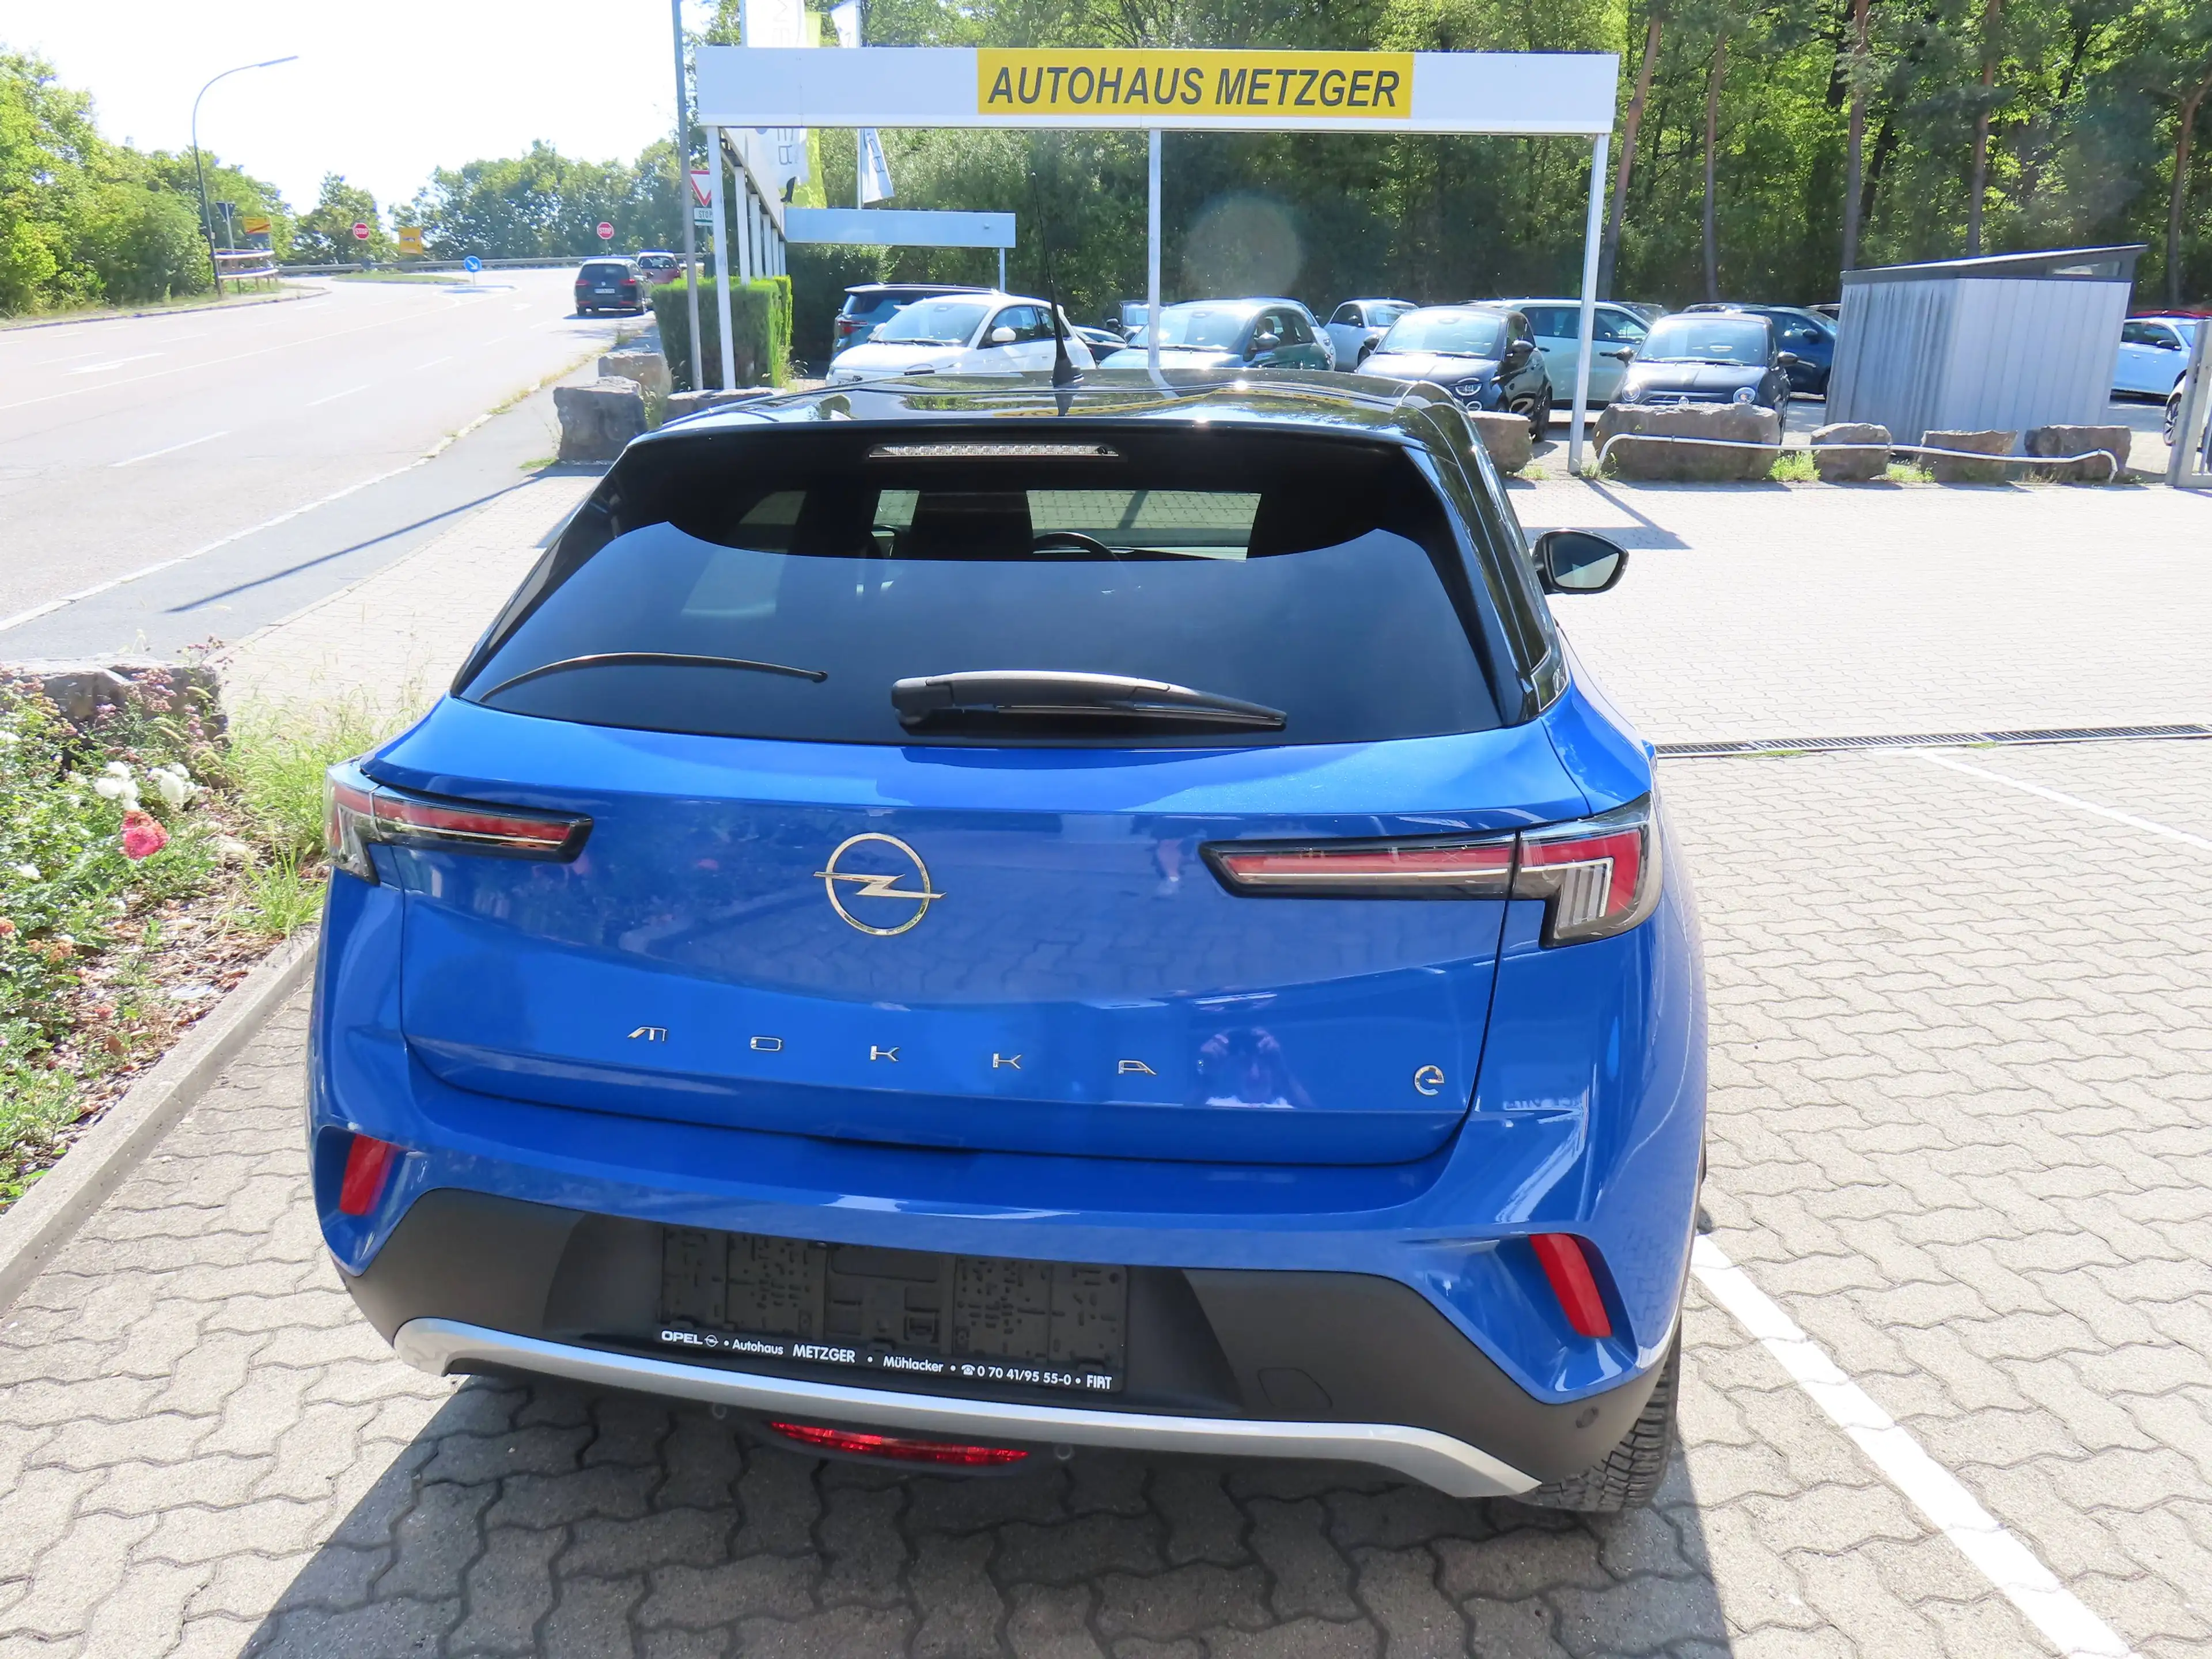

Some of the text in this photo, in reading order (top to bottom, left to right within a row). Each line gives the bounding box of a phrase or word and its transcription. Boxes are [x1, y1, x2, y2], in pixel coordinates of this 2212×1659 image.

[987, 67, 1400, 107] AUTOHAUS METZGER
[627, 1026, 1157, 1076] MOKKA
[661, 1330, 1113, 1389] OPEL Autohaus METZGER Mühlacker 0 70 41/95 55-0 FIAT
